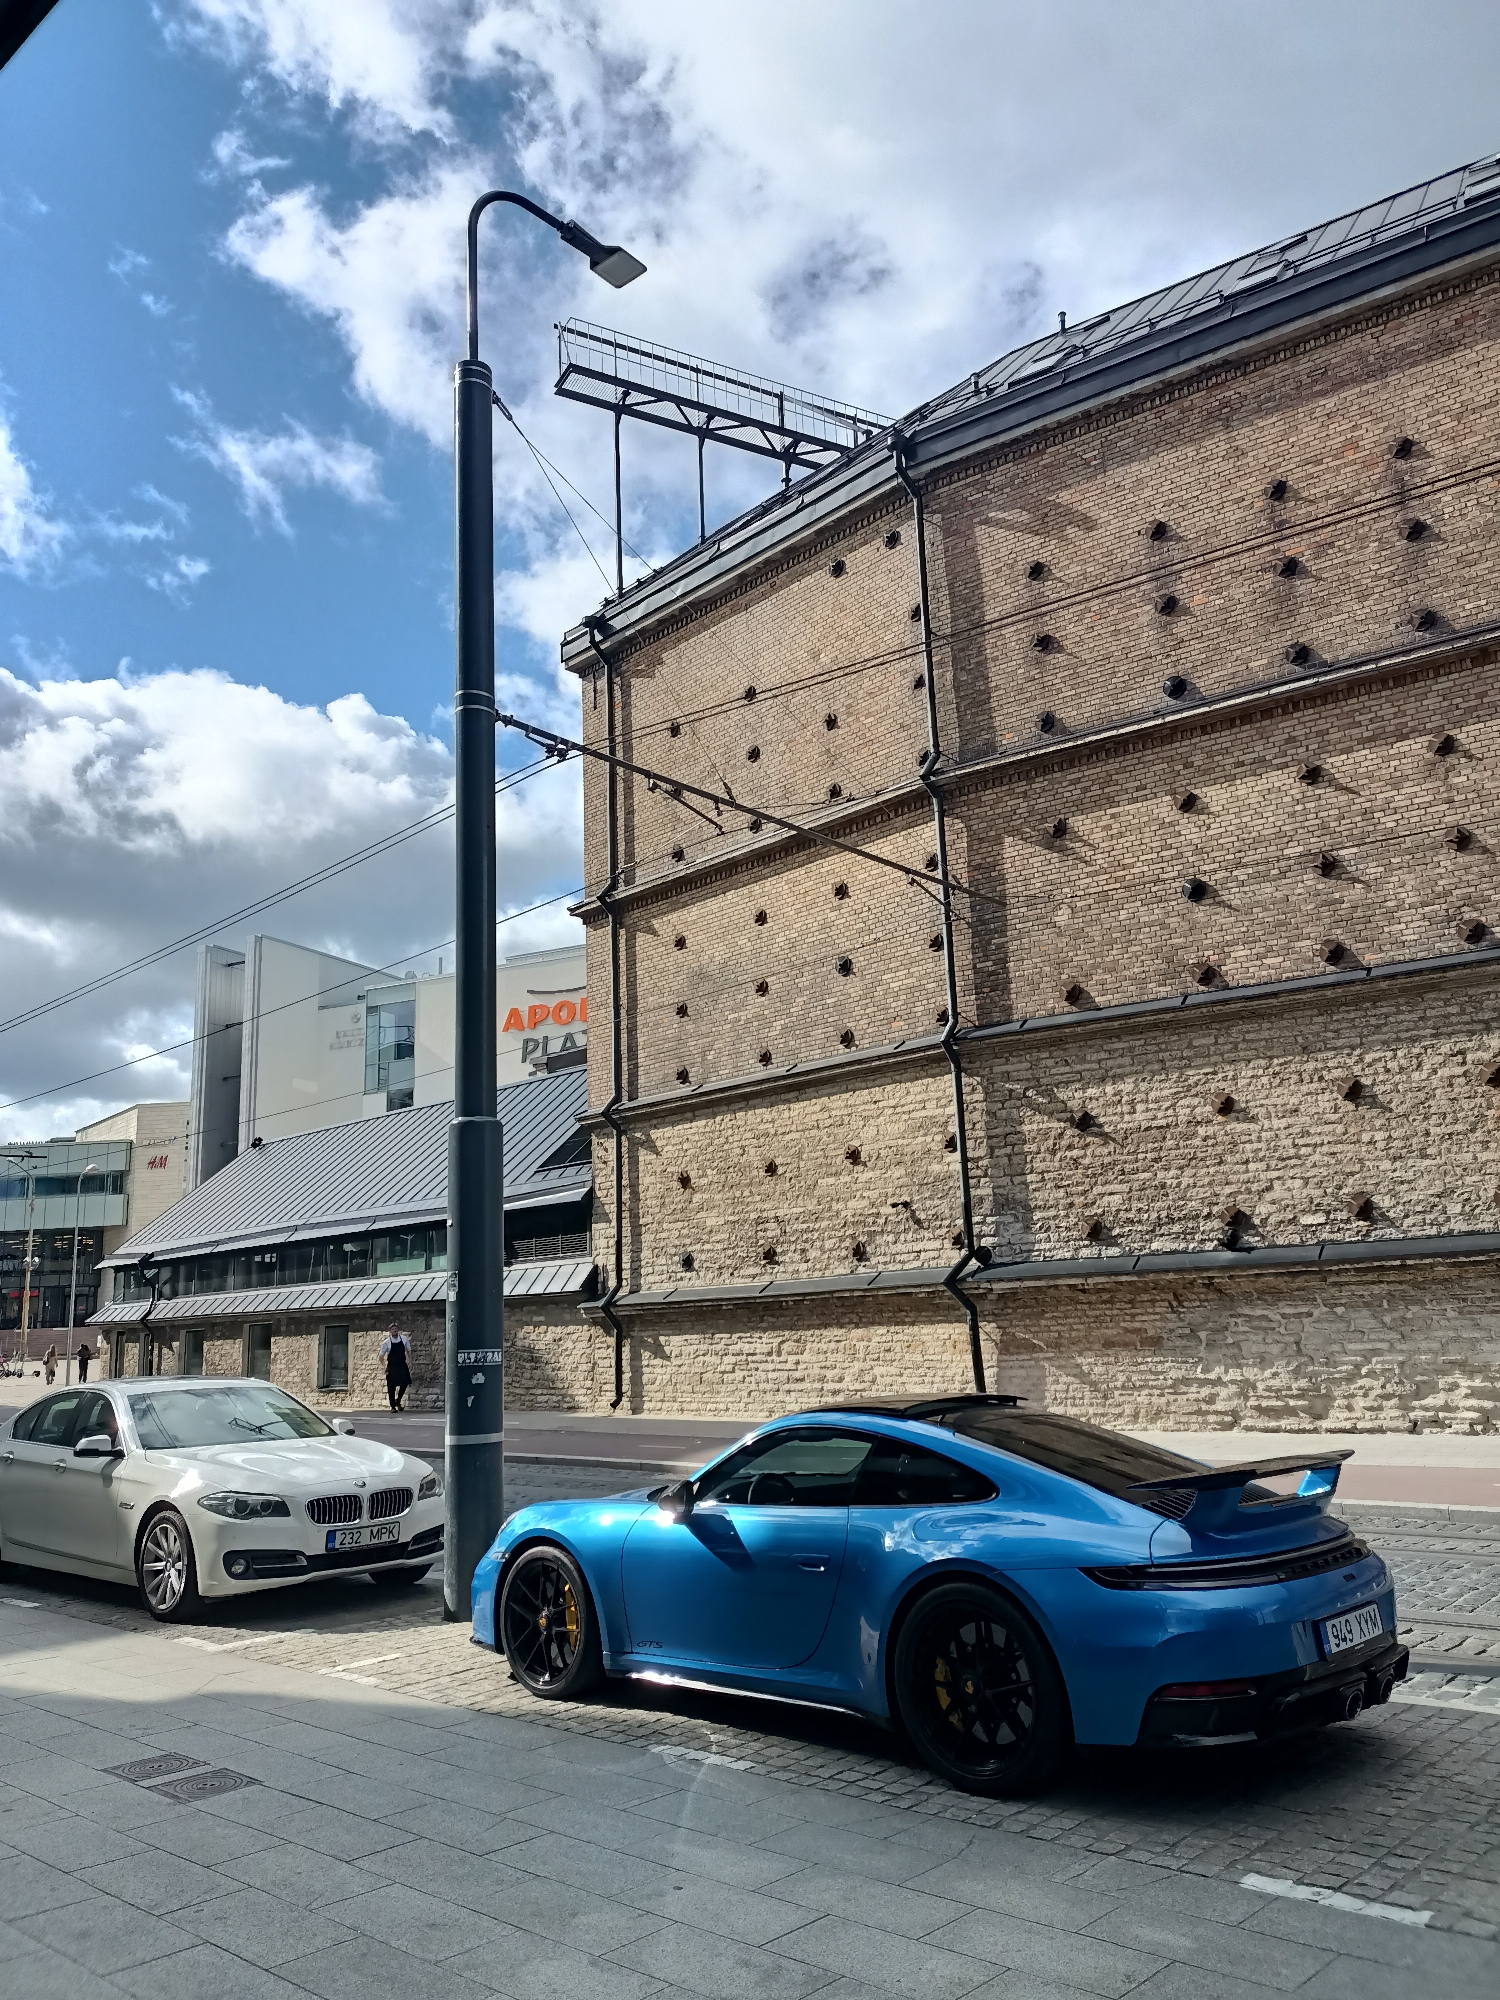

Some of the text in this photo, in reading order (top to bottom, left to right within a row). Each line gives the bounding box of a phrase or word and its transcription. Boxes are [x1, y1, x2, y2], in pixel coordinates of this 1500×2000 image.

[521, 1031, 587, 1063] PLA
[339, 1525, 397, 1546] 232 MPK
[1331, 1607, 1380, 1648] 949 XYM
[636, 1640, 663, 1649] GTS
